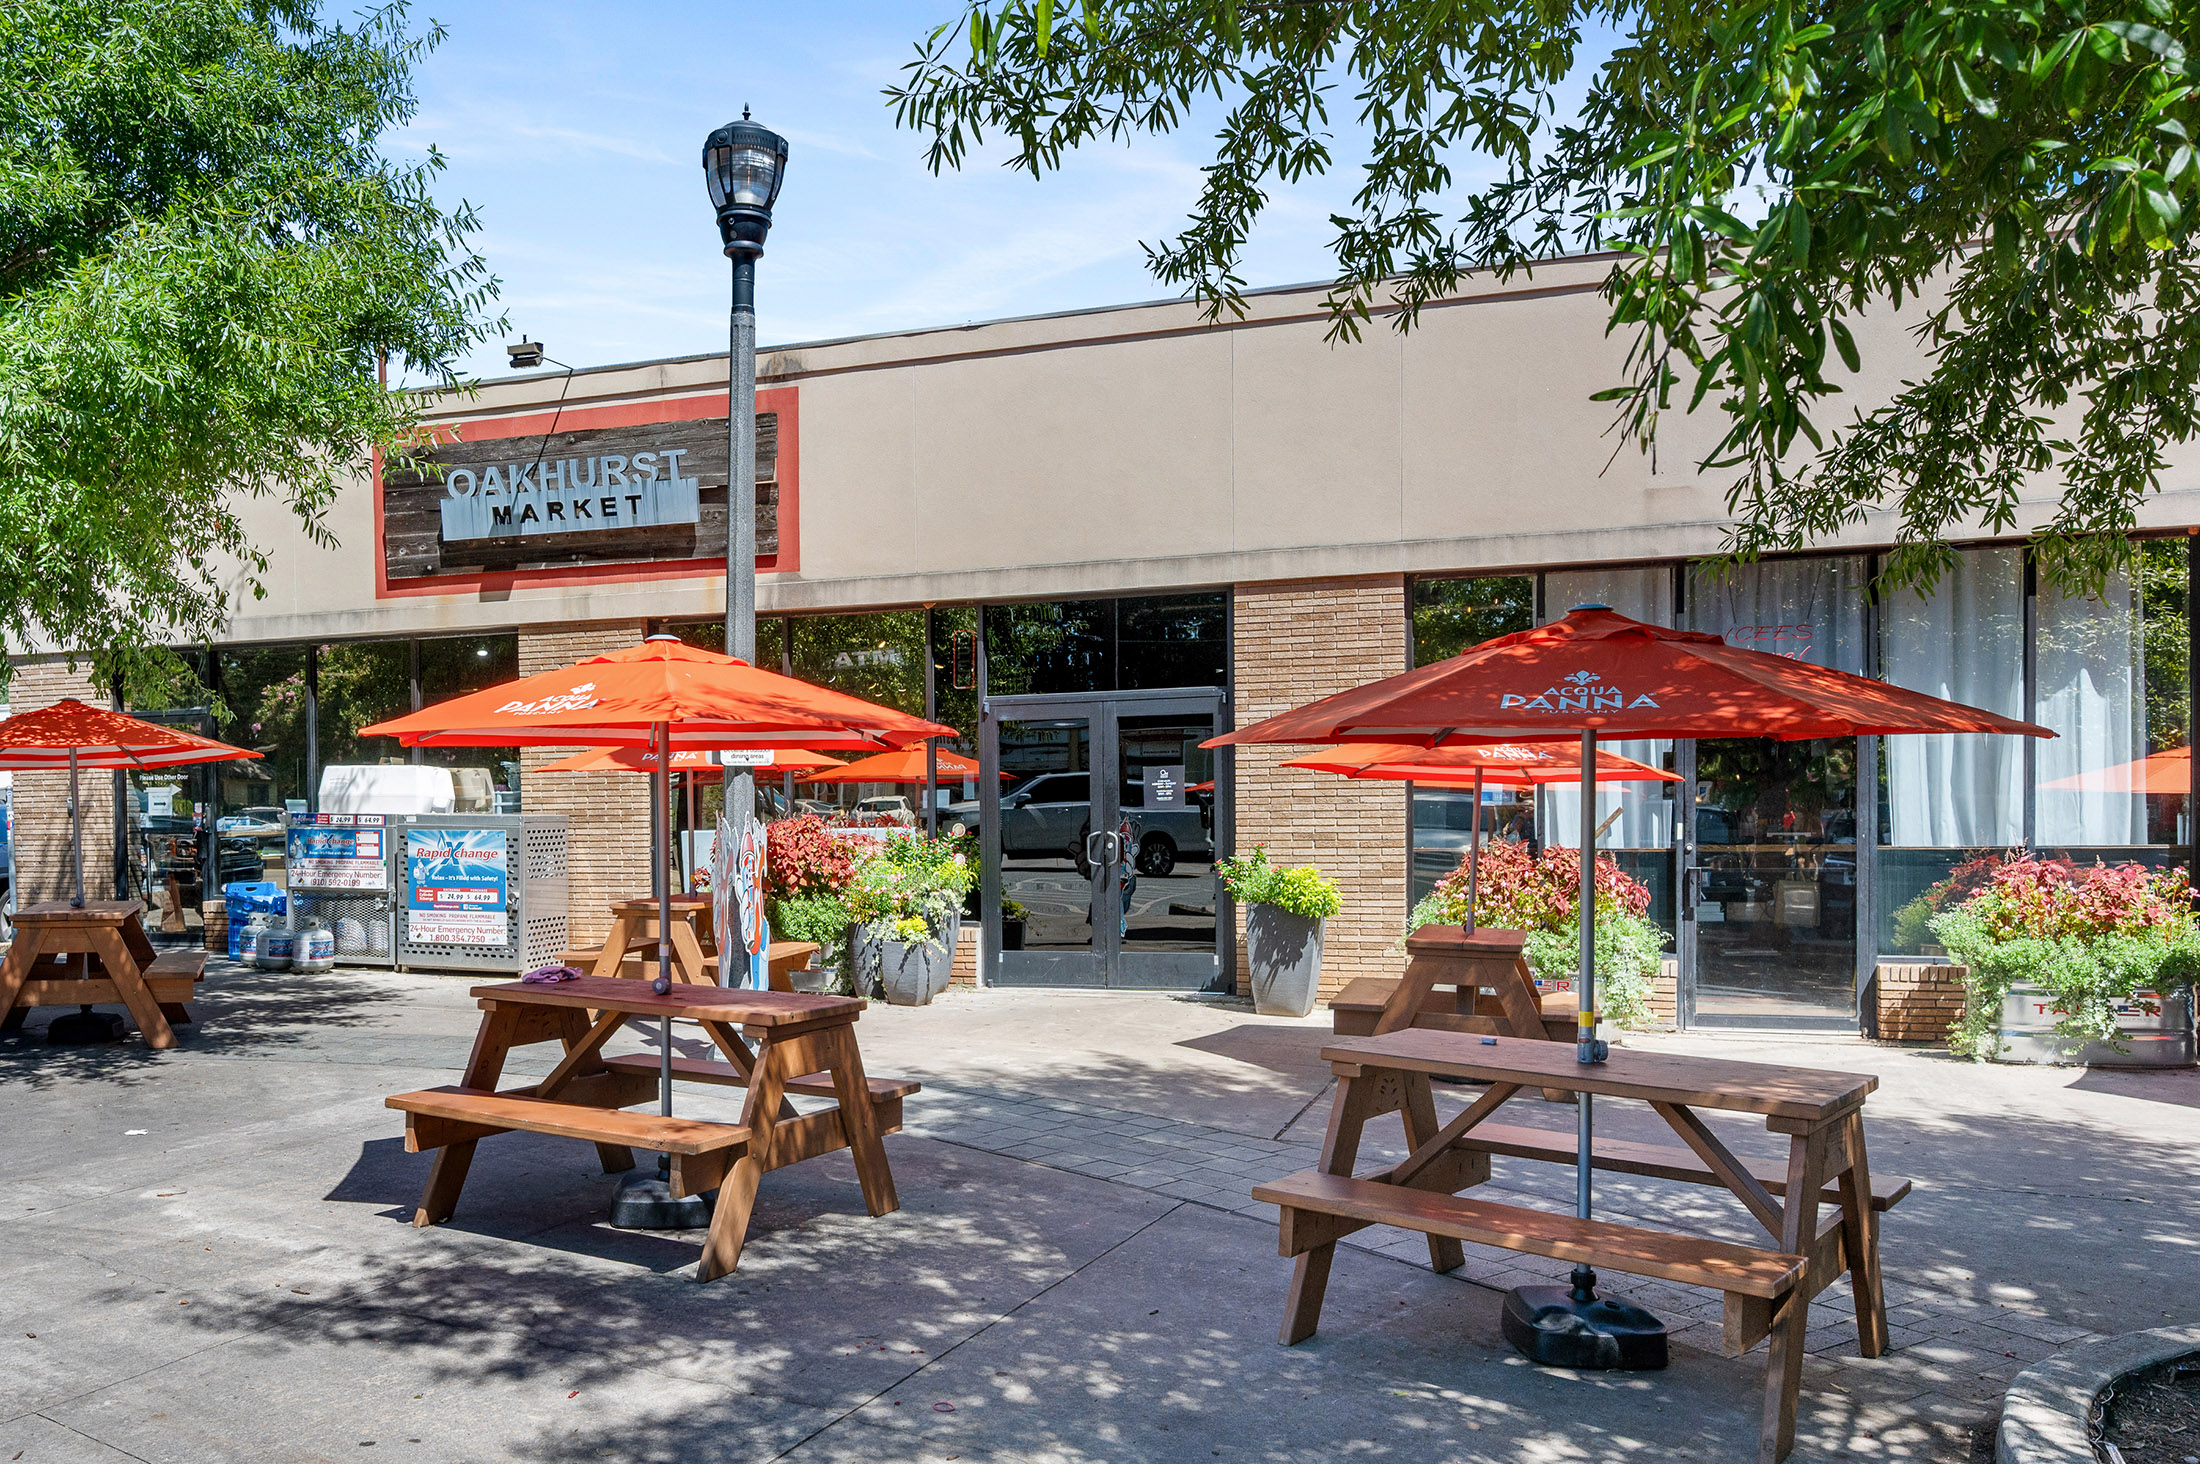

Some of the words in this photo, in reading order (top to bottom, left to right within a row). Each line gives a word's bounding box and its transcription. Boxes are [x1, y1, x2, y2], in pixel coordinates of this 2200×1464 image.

[446, 449, 688, 499] OAKHURST
[492, 495, 642, 525] MARKET
[1724, 625, 1813, 641] ICEES
[834, 649, 895, 666] ATM
[539, 693, 592, 702] ACQUA
[1543, 686, 1622, 695] ACQUA
[493, 699, 599, 713] PANNA
[1500, 693, 1660, 709] PANNA
[291, 870, 316, 878] 24-Hour
[317, 871, 353, 879] Emergency
[354, 871, 382, 879] Number:
[438, 925, 475, 934] Emergency
[477, 927, 505, 935] Number:
[430, 935, 485, 943] 1.800.354.7250
